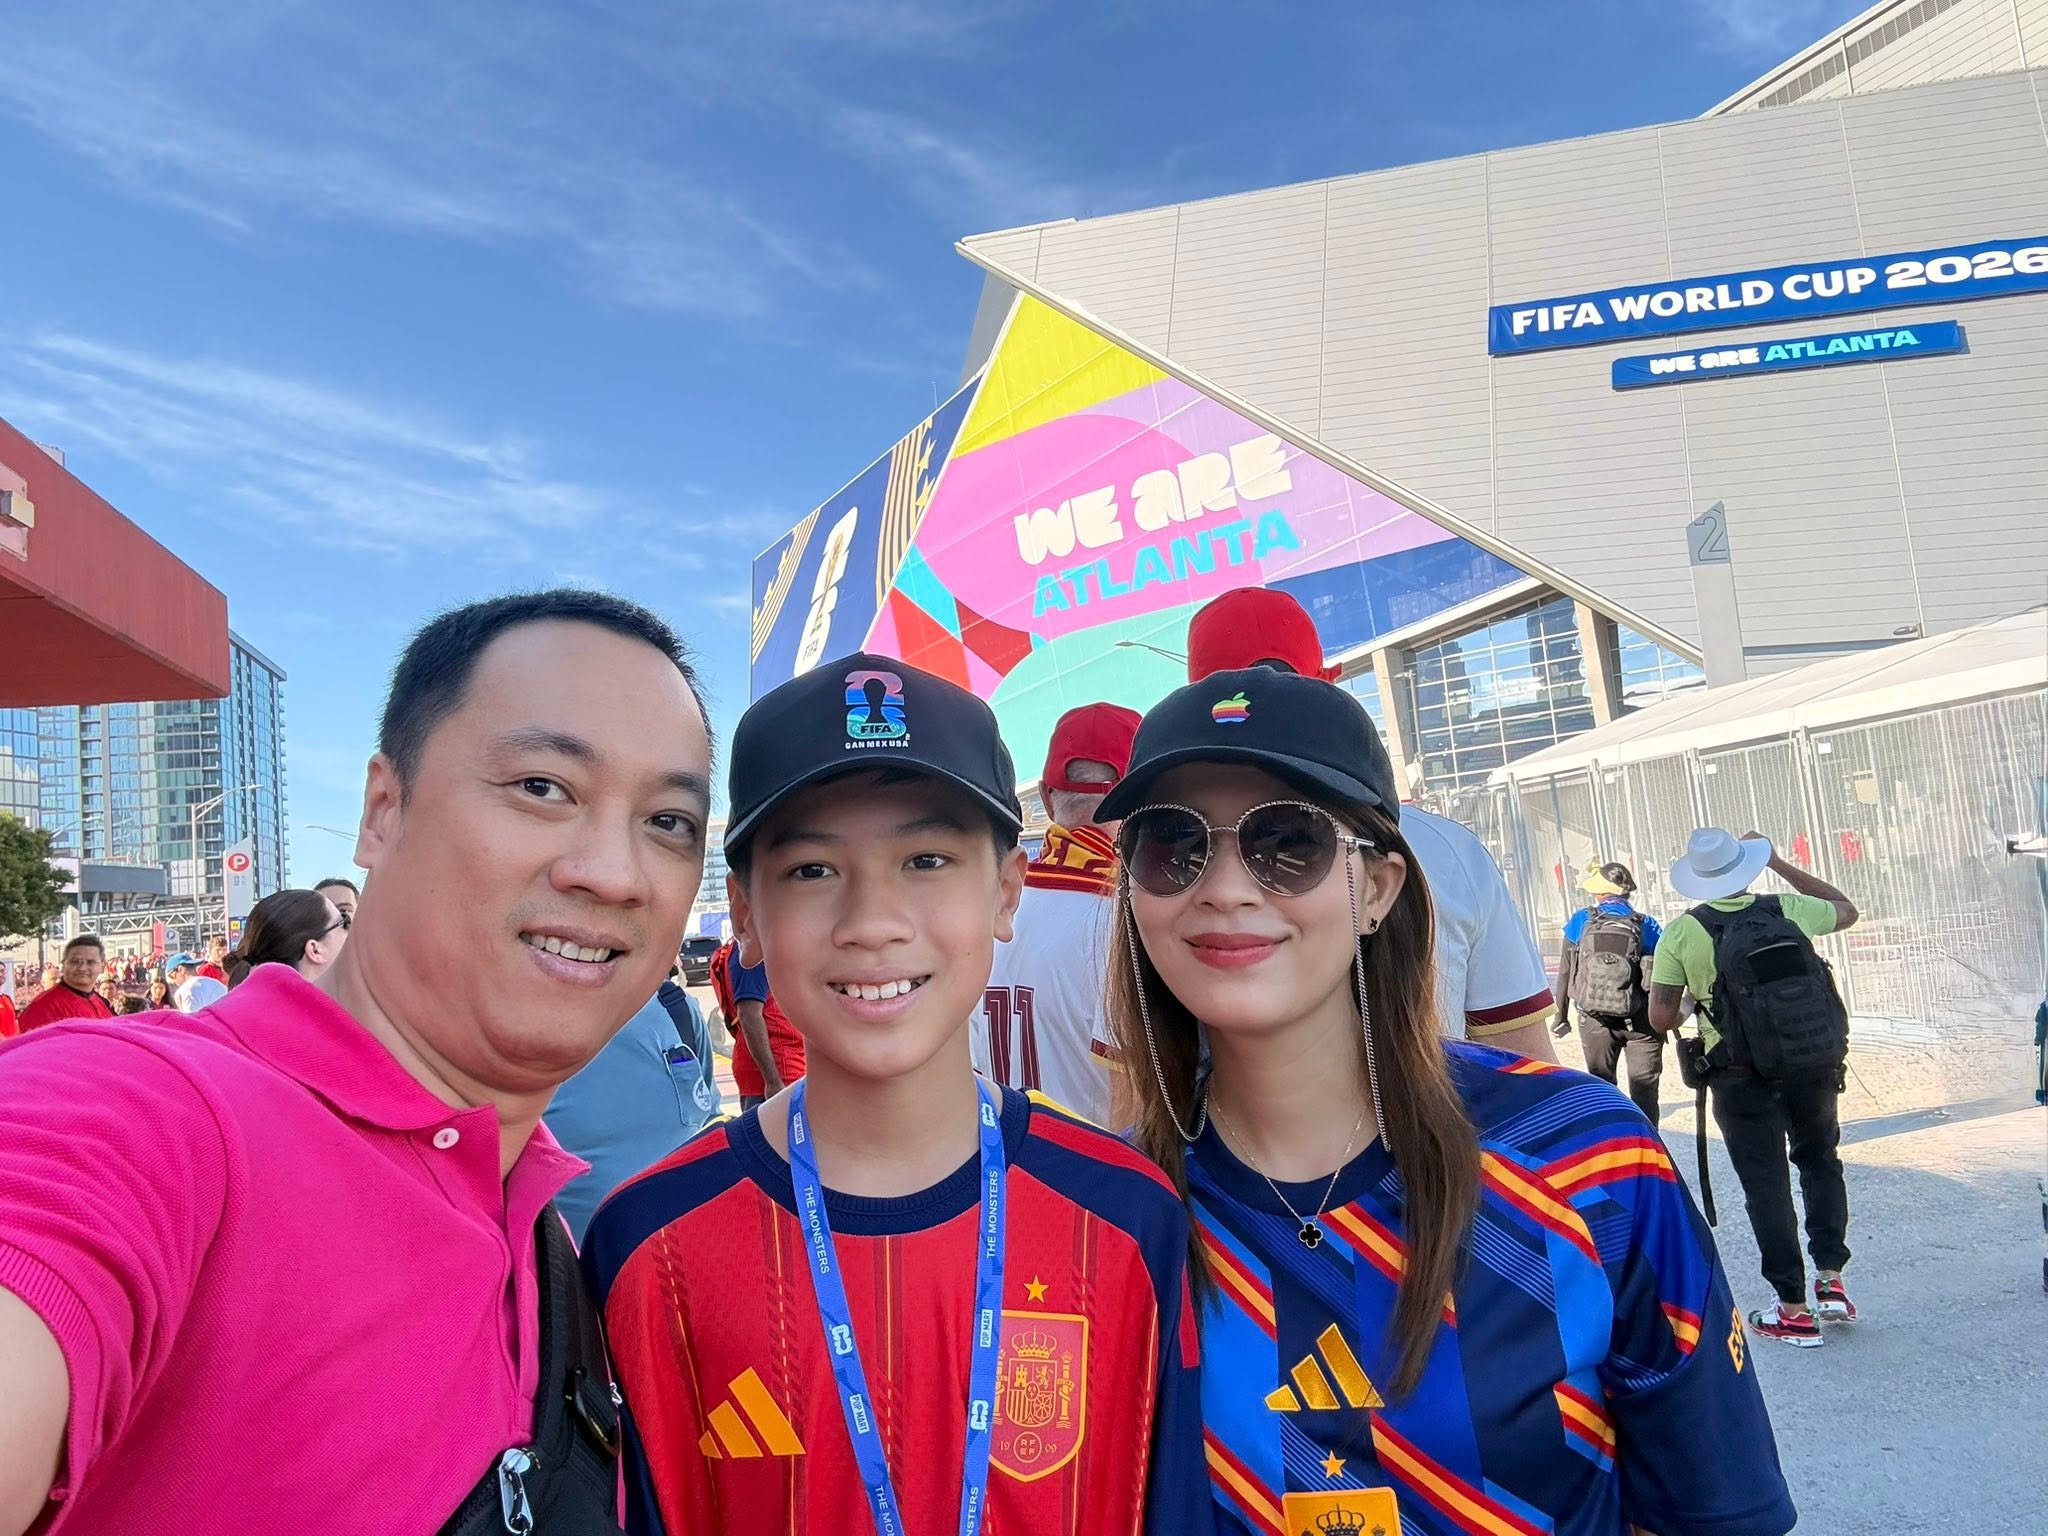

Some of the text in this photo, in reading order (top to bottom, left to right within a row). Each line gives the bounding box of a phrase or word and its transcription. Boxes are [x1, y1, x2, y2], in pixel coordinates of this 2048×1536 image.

[1511, 246, 2048, 336] FIFA WORLD CUP 2026
[1650, 329, 1921, 375] WE ARE ATLANTA
[1013, 432, 1293, 566] WE ARE
[1032, 508, 1300, 618] ATLANTA
[860, 724, 894, 735] FIFA
[983, 984, 1043, 1092] 11
[804, 1185, 830, 1275] THE MONSTERS
[986, 1171, 999, 1259] THE MONSTERS
[983, 1311, 991, 1331] MART
[852, 1396, 868, 1432] POP MART
[875, 1485, 888, 1509] THE
